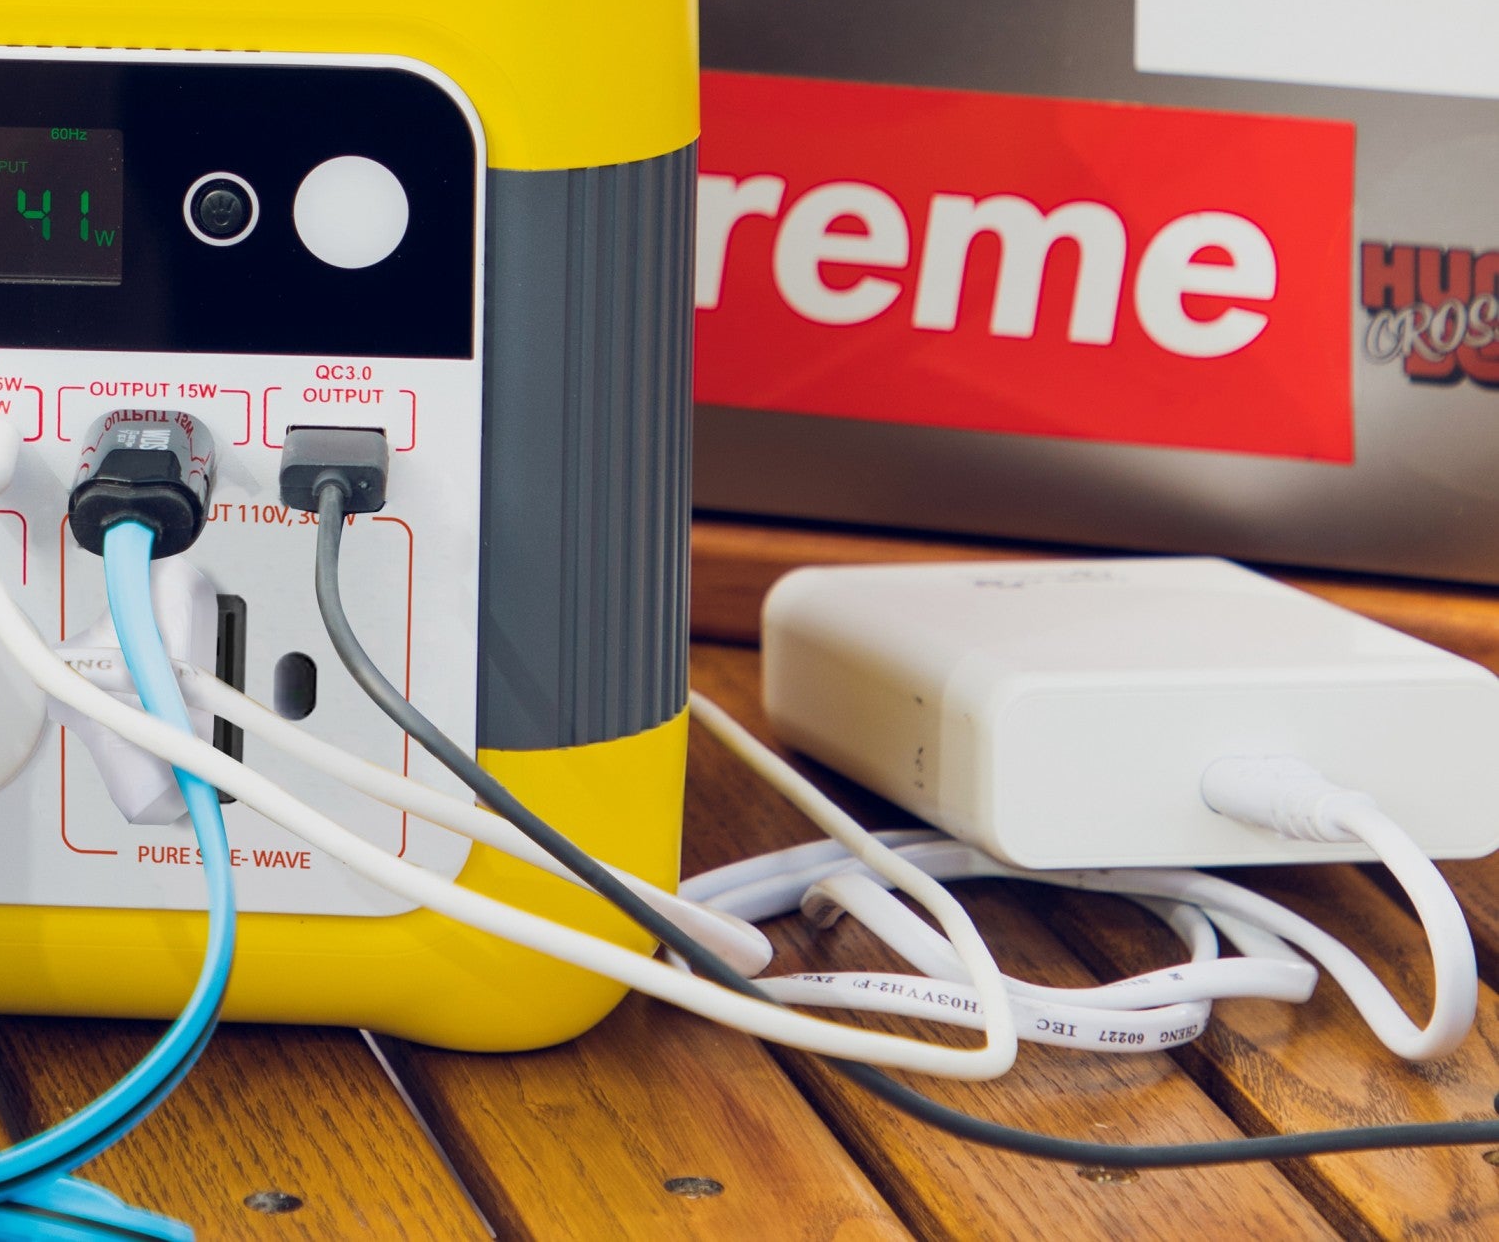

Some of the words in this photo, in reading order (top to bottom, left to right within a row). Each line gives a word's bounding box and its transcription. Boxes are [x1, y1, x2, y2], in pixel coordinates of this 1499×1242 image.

[50, 127, 87, 141] 60Hz
[1366, 294, 1499, 365] CROS
[315, 364, 372, 381] QC3.0
[89, 381, 170, 398] OUTPUT
[177, 383, 217, 399] 15W
[302, 387, 384, 404] OUTPUT
[138, 846, 190, 865] PURE
[252, 850, 311, 870] WAVE
[1036, 1018, 1078, 1038] IEC
[1099, 1029, 1145, 1045] 60227
